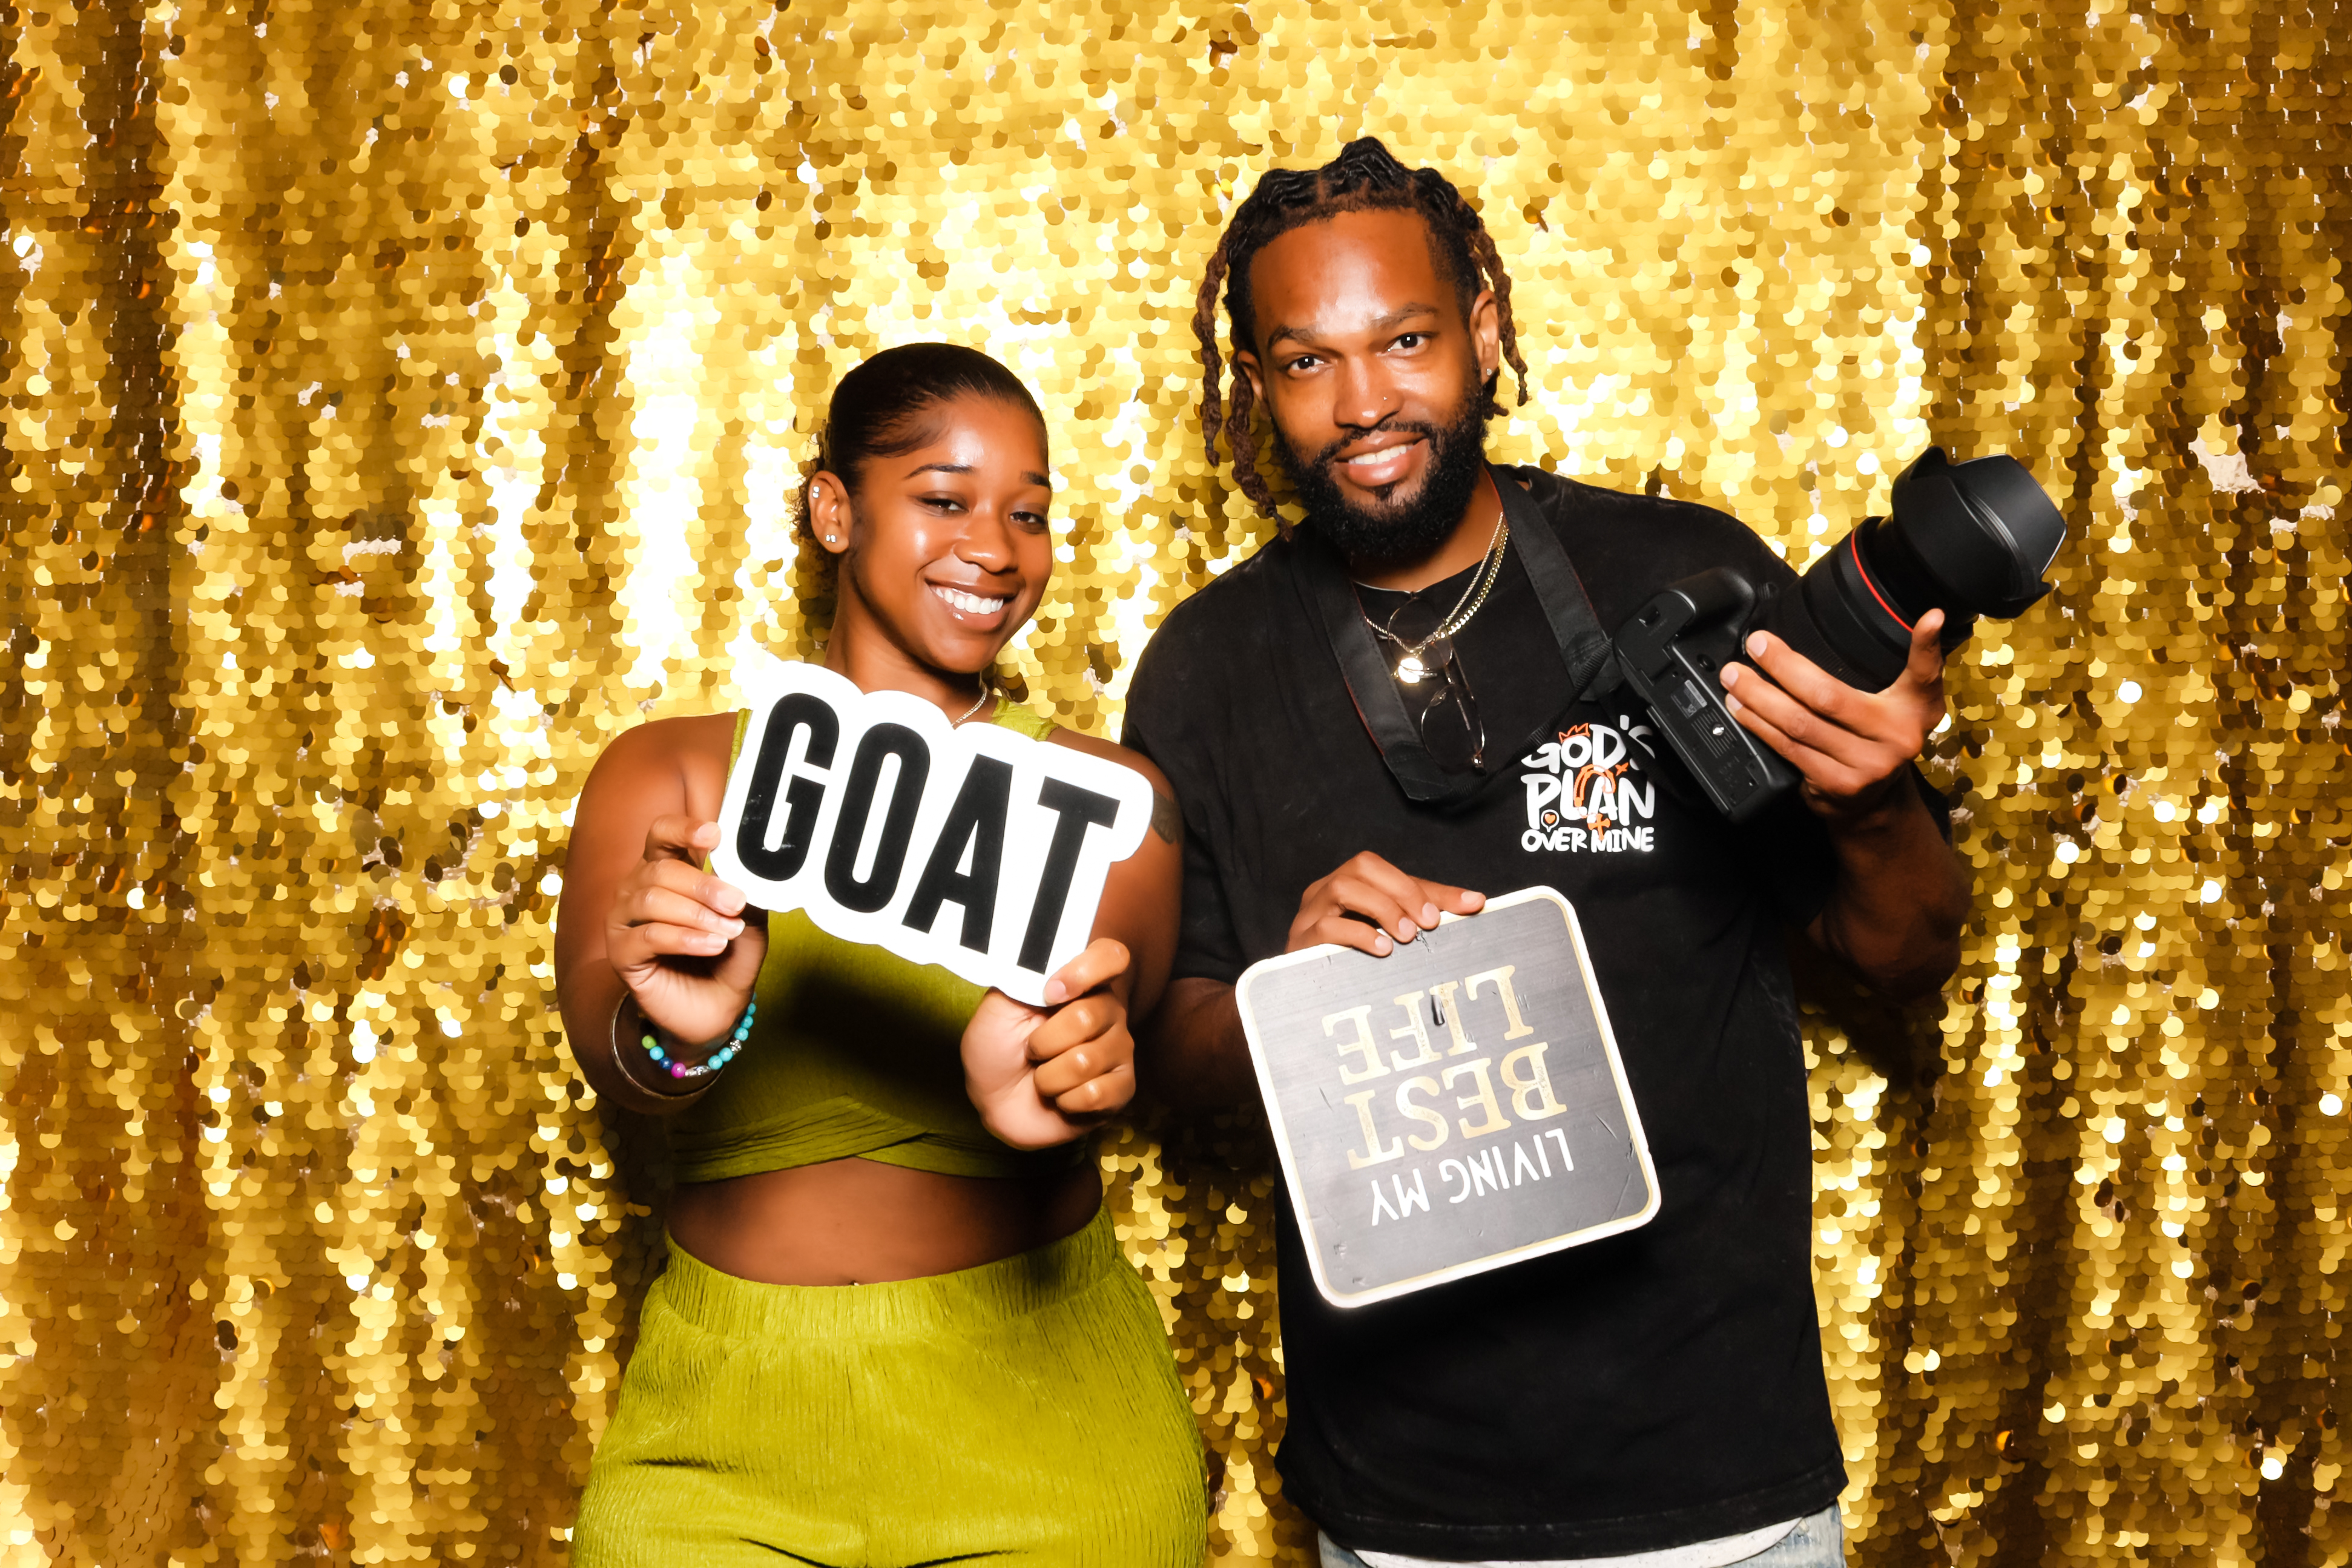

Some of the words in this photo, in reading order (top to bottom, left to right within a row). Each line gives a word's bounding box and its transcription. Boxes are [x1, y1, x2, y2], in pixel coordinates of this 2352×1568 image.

[736, 692, 1121, 975] GOAT
[1520, 768, 1656, 829] PLAN
[1521, 826, 1587, 852] OVER
[1590, 826, 1655, 853] MINE
[1321, 964, 1534, 1086] LIFE
[1343, 1041, 1568, 1171] BEST
[1370, 1166, 1431, 1227] MY
[1438, 1128, 1575, 1205] LIVING
